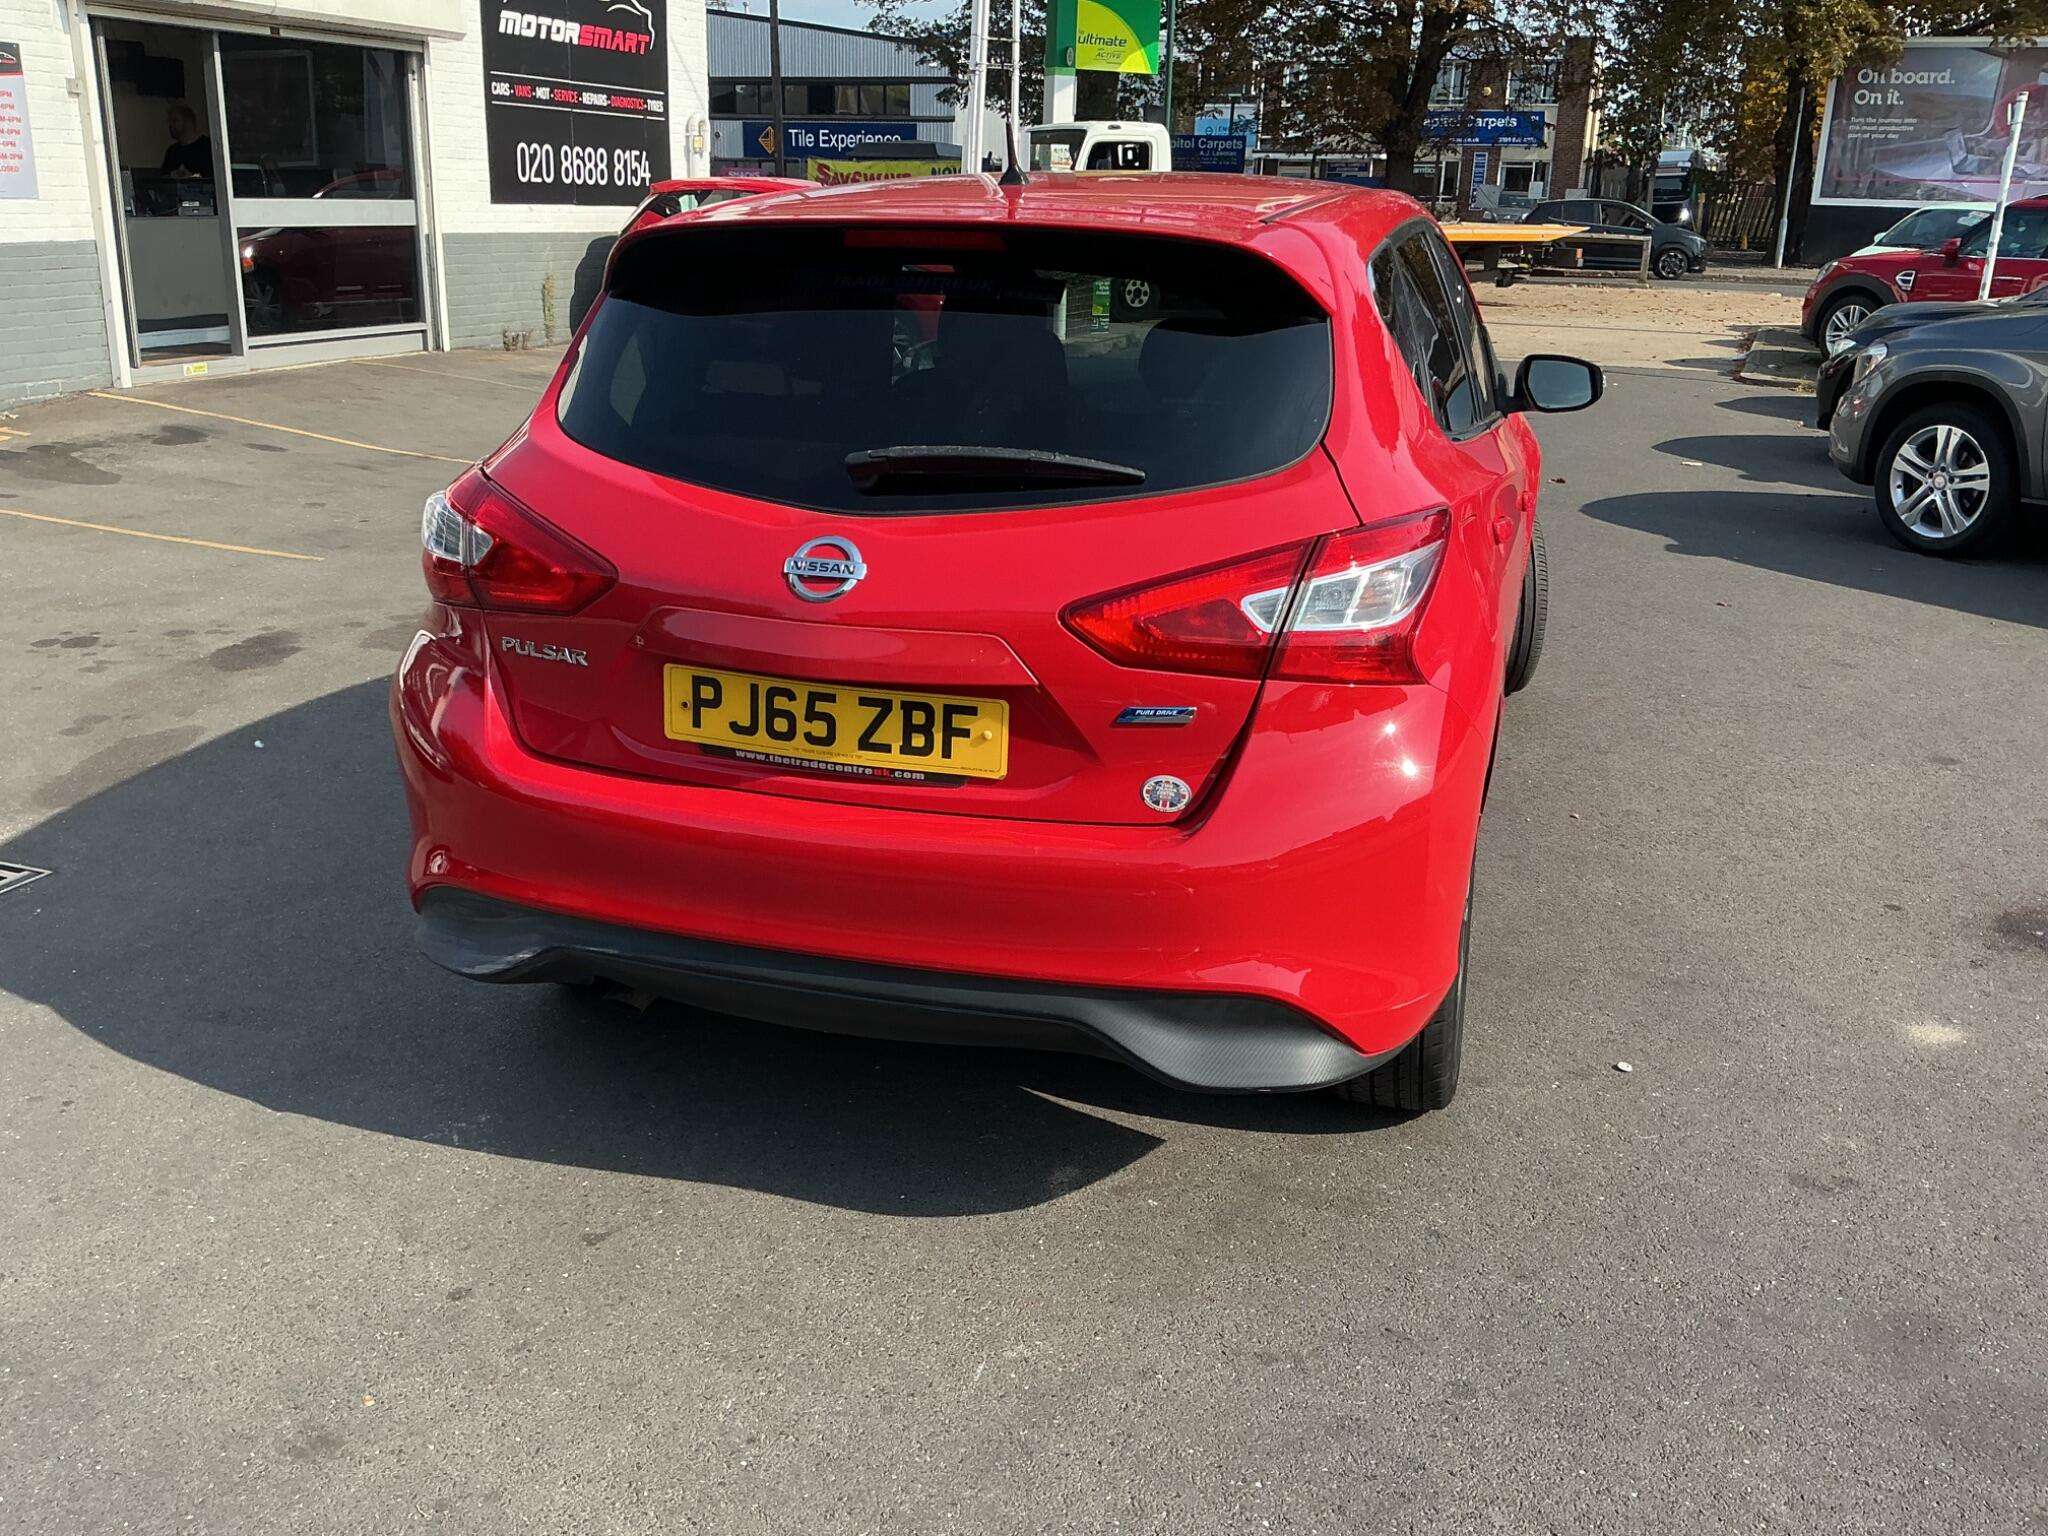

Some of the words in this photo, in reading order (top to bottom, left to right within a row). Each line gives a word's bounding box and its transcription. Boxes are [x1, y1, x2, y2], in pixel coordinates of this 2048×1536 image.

[499, 9, 650, 55] MOTORSMART
[1078, 32, 1127, 47] ultimate
[1857, 68, 1885, 84] On
[1890, 68, 1955, 84] board.
[491, 81, 510, 96] CARS
[514, 85, 532, 98] VANS
[536, 87, 550, 100] MOT
[553, 89, 579, 104] SERVICE
[582, 92, 607, 106] REPAIRS
[611, 96, 645, 110] DIAGNOSTICS
[647, 99, 664, 113] TYRES
[1854, 89, 1882, 105] On
[1887, 89, 1904, 105] it.
[788, 129, 814, 148] Tile
[1198, 137, 1244, 151] Carpets
[516, 142, 554, 183] 020
[561, 145, 608, 186] 8688
[613, 149, 651, 187] 8154
[791, 559, 857, 576] NISSAN
[501, 636, 589, 667] PULSAR
[691, 674, 838, 748] PJ65
[856, 695, 980, 761] ZBF
